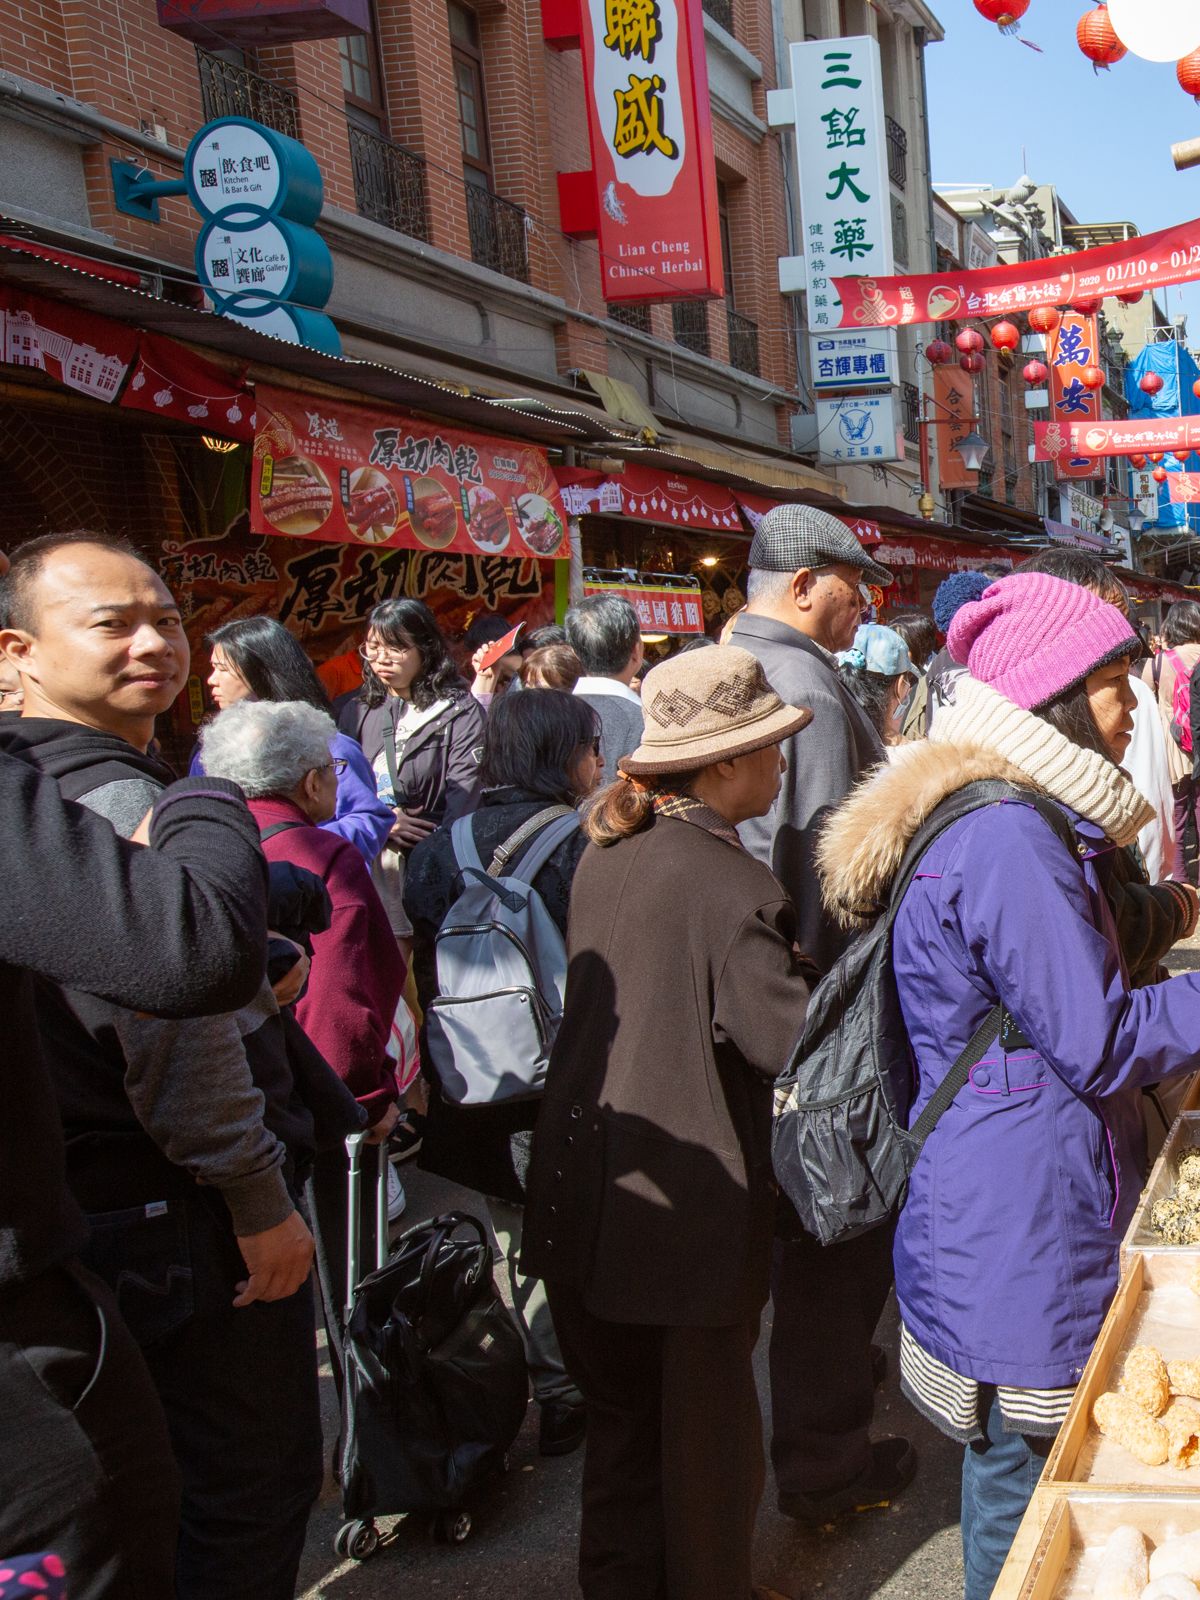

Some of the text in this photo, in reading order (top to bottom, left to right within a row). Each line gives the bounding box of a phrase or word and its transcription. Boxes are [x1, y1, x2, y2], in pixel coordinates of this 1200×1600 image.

[604, 0, 679, 161] 聯盛
[223, 176, 249, 184] Kitchen
[249, 184, 263, 192] Gift
[821, 53, 874, 306] 三銘大藥
[233, 247, 264, 264] 文化
[619, 240, 690, 257] Lian Cheng
[265, 264, 288, 272] Gallery
[609, 258, 703, 278] Chinese Herbal
[809, 223, 829, 325] 健保特約藥局
[1079, 275, 1100, 287] 2020
[1106, 259, 1147, 282] 01/10
[966, 283, 1062, 311] 台北年貨大街
[818, 353, 886, 377] 杏輝專櫃
[1052, 325, 1095, 466] 萬安
[369, 427, 484, 486] 厚切肉乾
